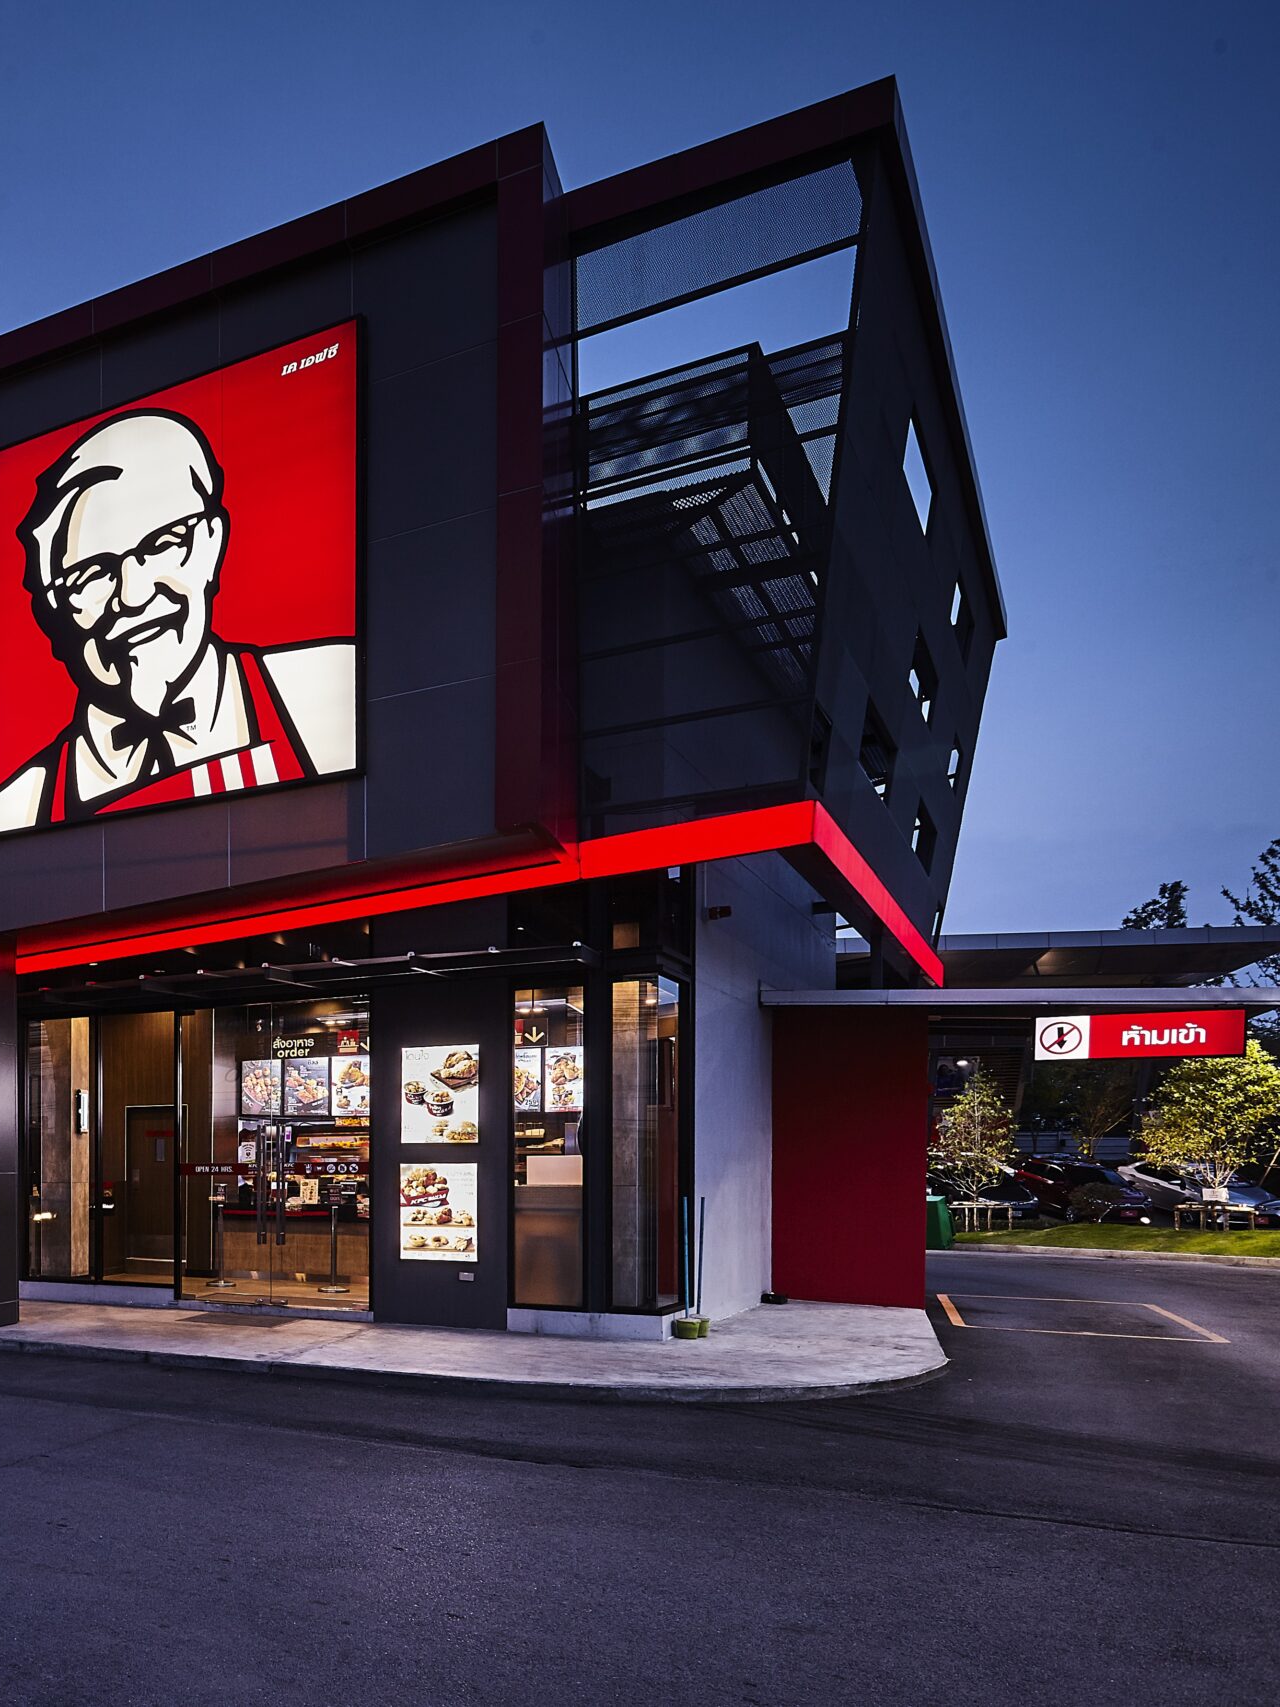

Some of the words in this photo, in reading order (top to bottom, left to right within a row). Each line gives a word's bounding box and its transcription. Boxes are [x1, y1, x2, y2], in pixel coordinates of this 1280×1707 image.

[1121, 1022, 1206, 1046] ห้ามเข้า
[272, 1036, 315, 1049] สั่งอาหาร
[277, 1047, 310, 1058] order
[195, 1165, 210, 1173] OPEN
[211, 1165, 219, 1173] 24
